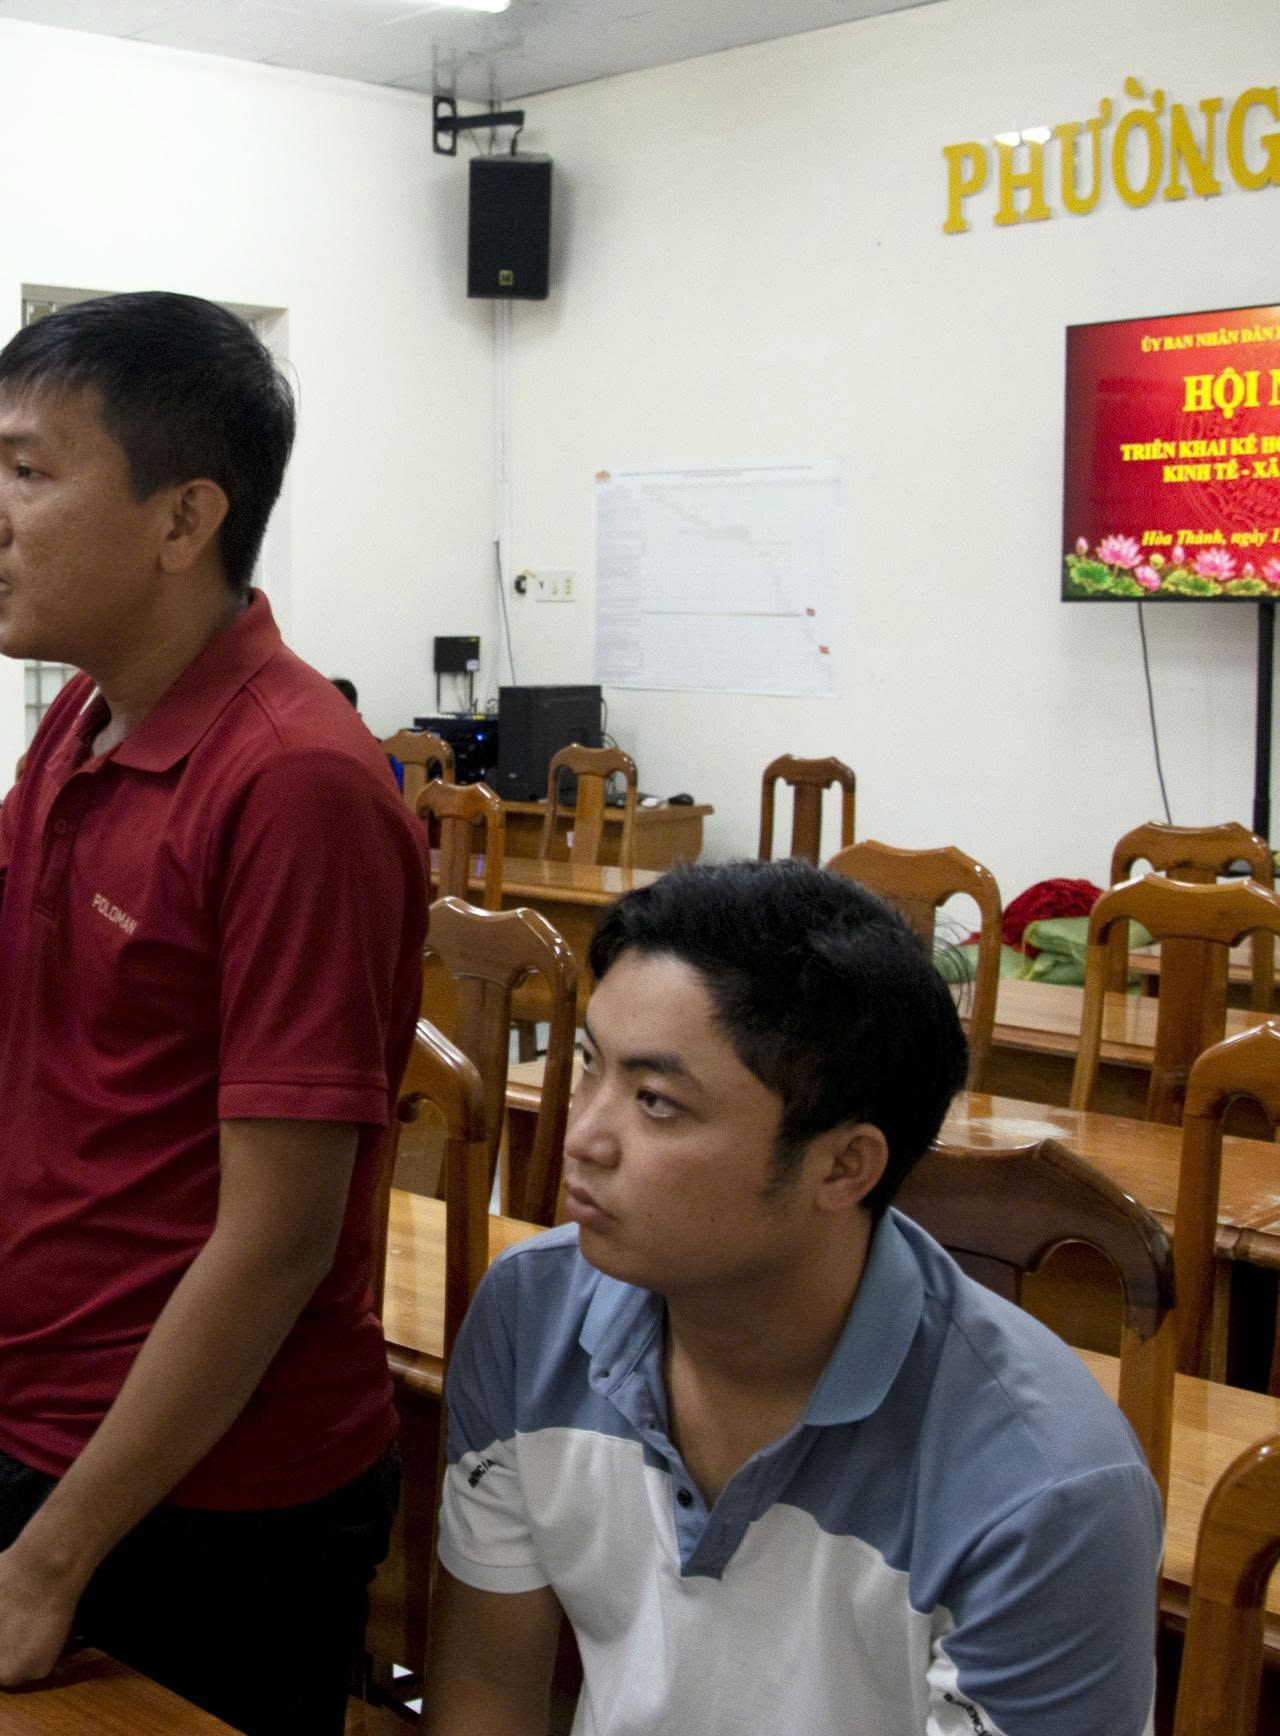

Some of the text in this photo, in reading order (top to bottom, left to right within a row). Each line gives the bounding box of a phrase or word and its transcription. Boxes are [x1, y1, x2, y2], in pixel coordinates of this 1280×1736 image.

[942, 75, 1280, 234] PHƯỜNG
[1164, 335, 1194, 351] BAN
[1196, 327, 1239, 347] NHÂN
[1241, 325, 1274, 343] DÂN
[1183, 366, 1261, 419] HỘI
[1179, 438, 1226, 458] KHAI
[1230, 432, 1257, 455] KẾ
[1163, 463, 1211, 483] KINH
[1214, 458, 1239, 480] TẾ
[1231, 528, 1268, 548] ngày
